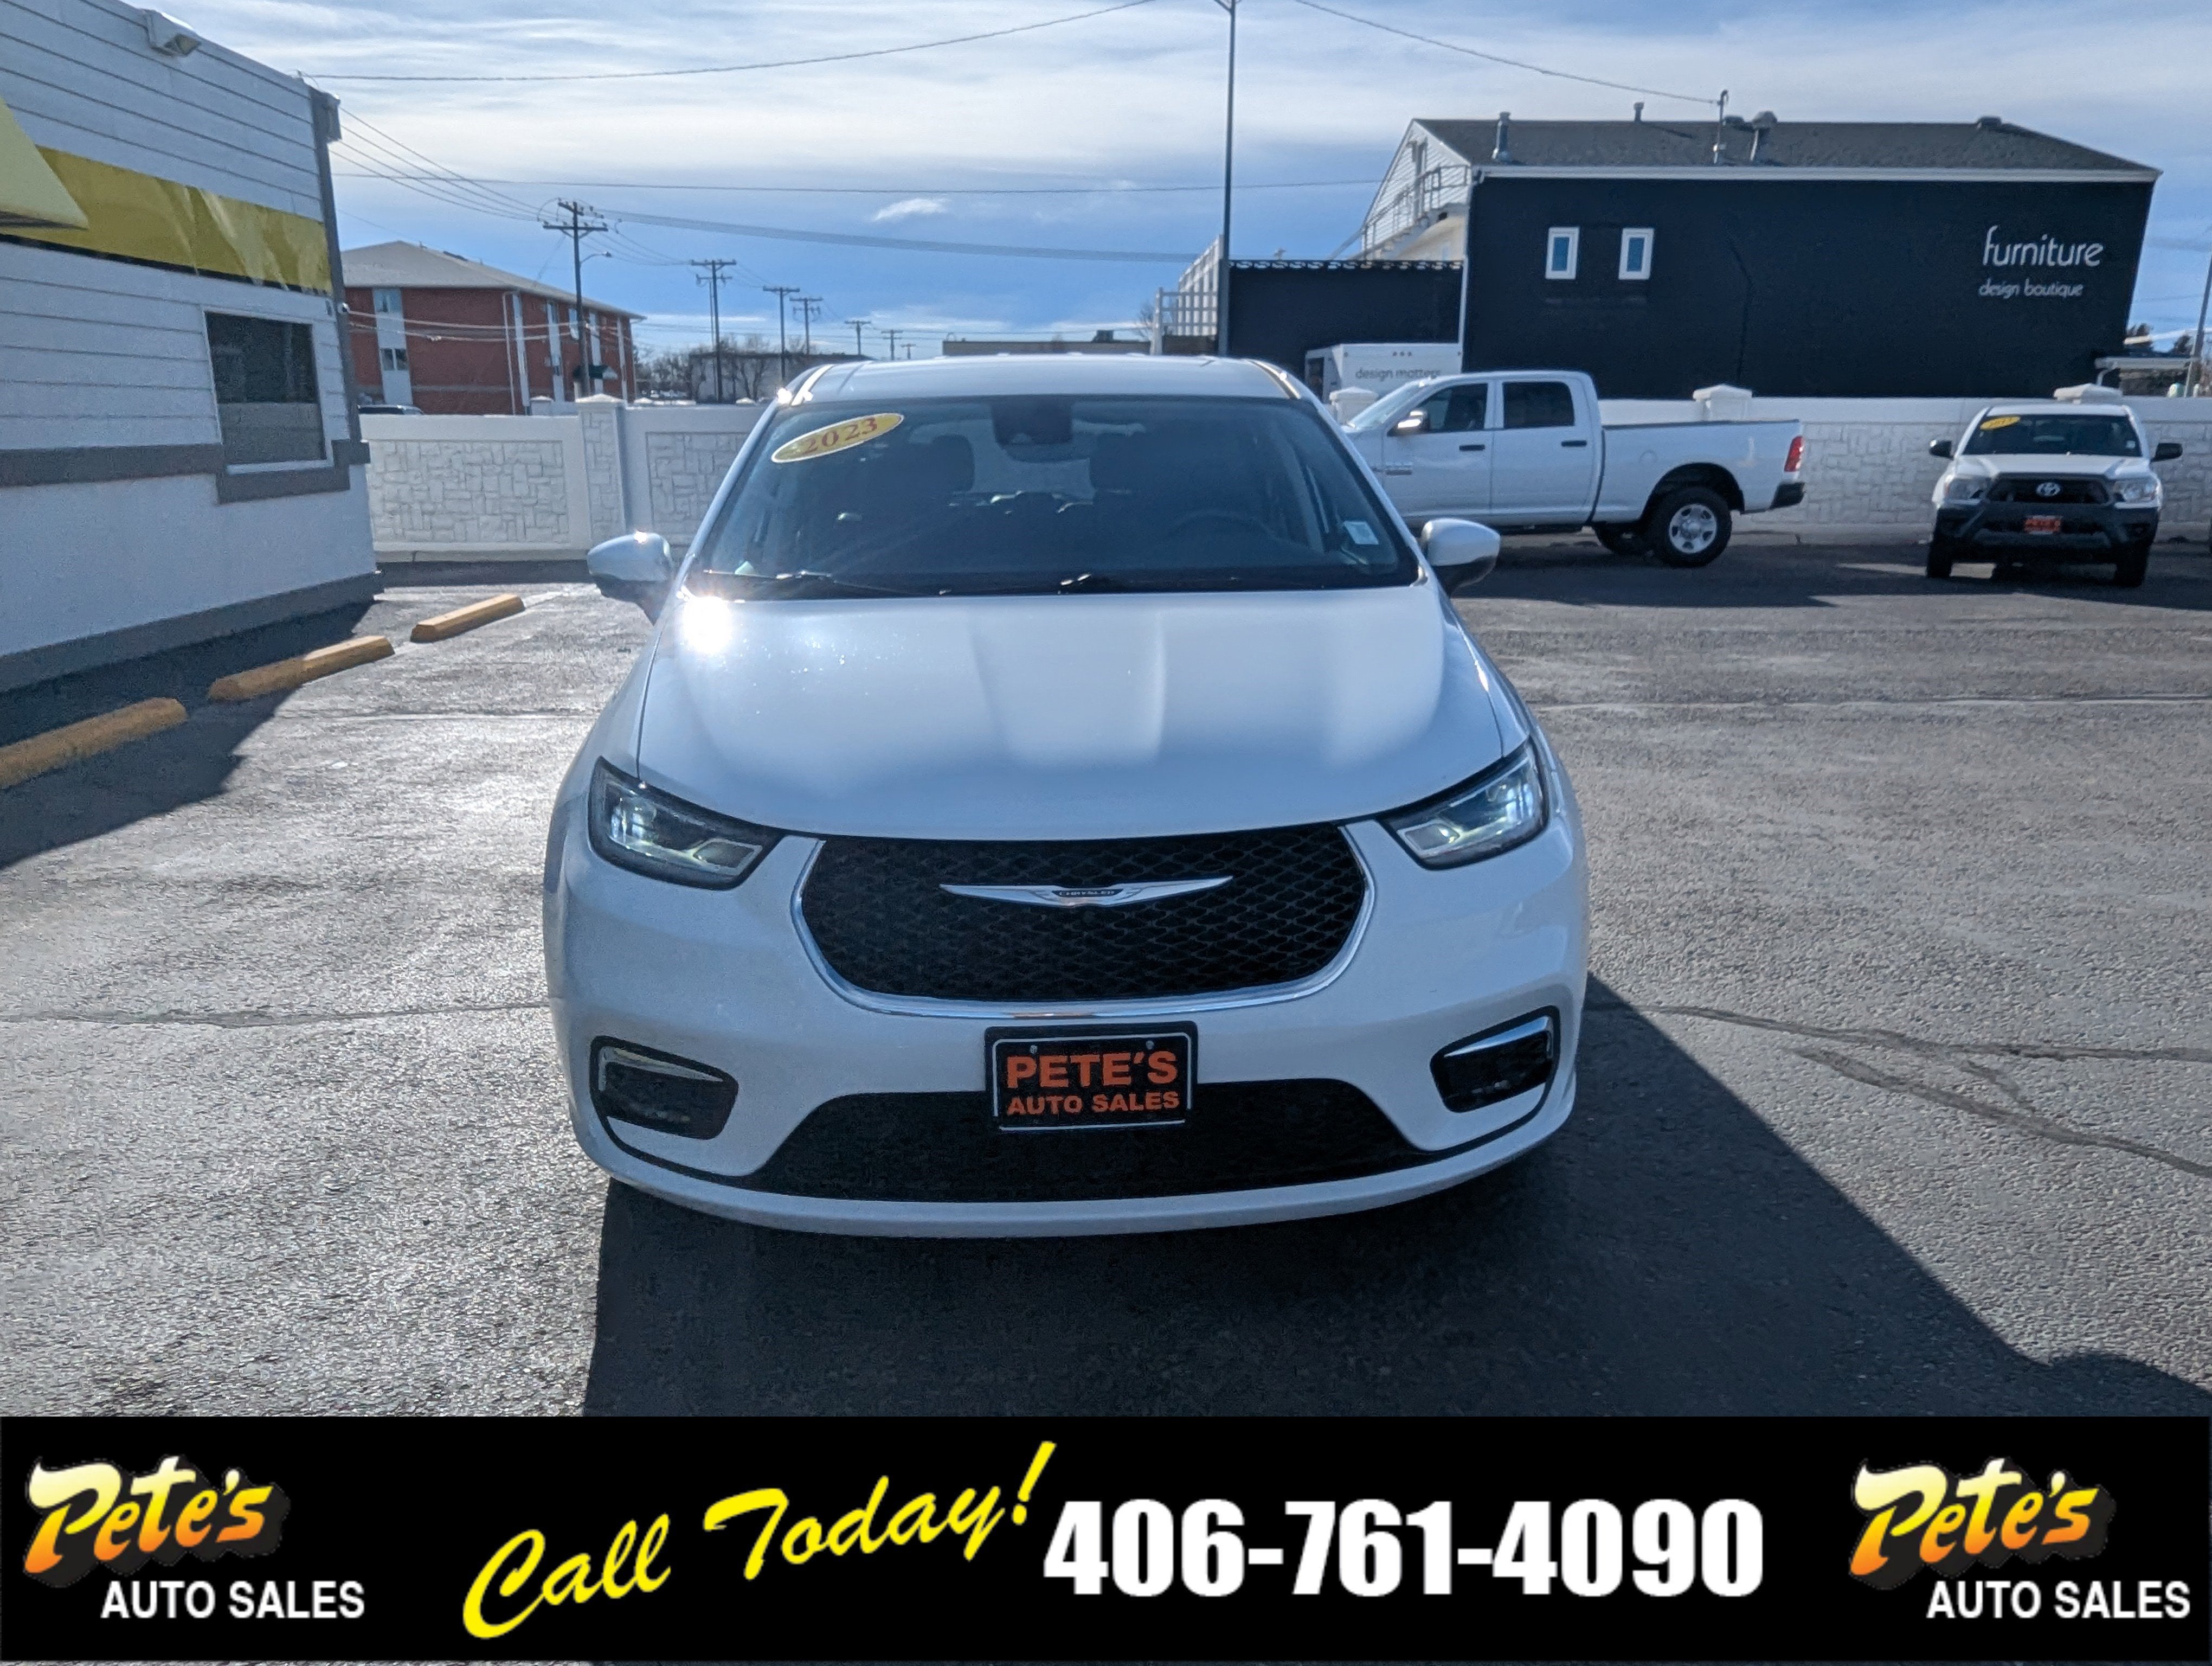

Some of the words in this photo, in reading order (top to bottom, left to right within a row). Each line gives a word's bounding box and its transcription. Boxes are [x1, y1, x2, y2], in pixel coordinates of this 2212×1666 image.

[1982, 225, 2103, 266] furniture
[1979, 278, 2020, 299] design
[2023, 278, 2084, 298] boutique
[1356, 367, 1393, 381] design
[803, 416, 877, 454] 2023
[1007, 1050, 1178, 1088] PETE'S
[1007, 1094, 1083, 1116] AUTO
[1091, 1091, 1180, 1113] SALES
